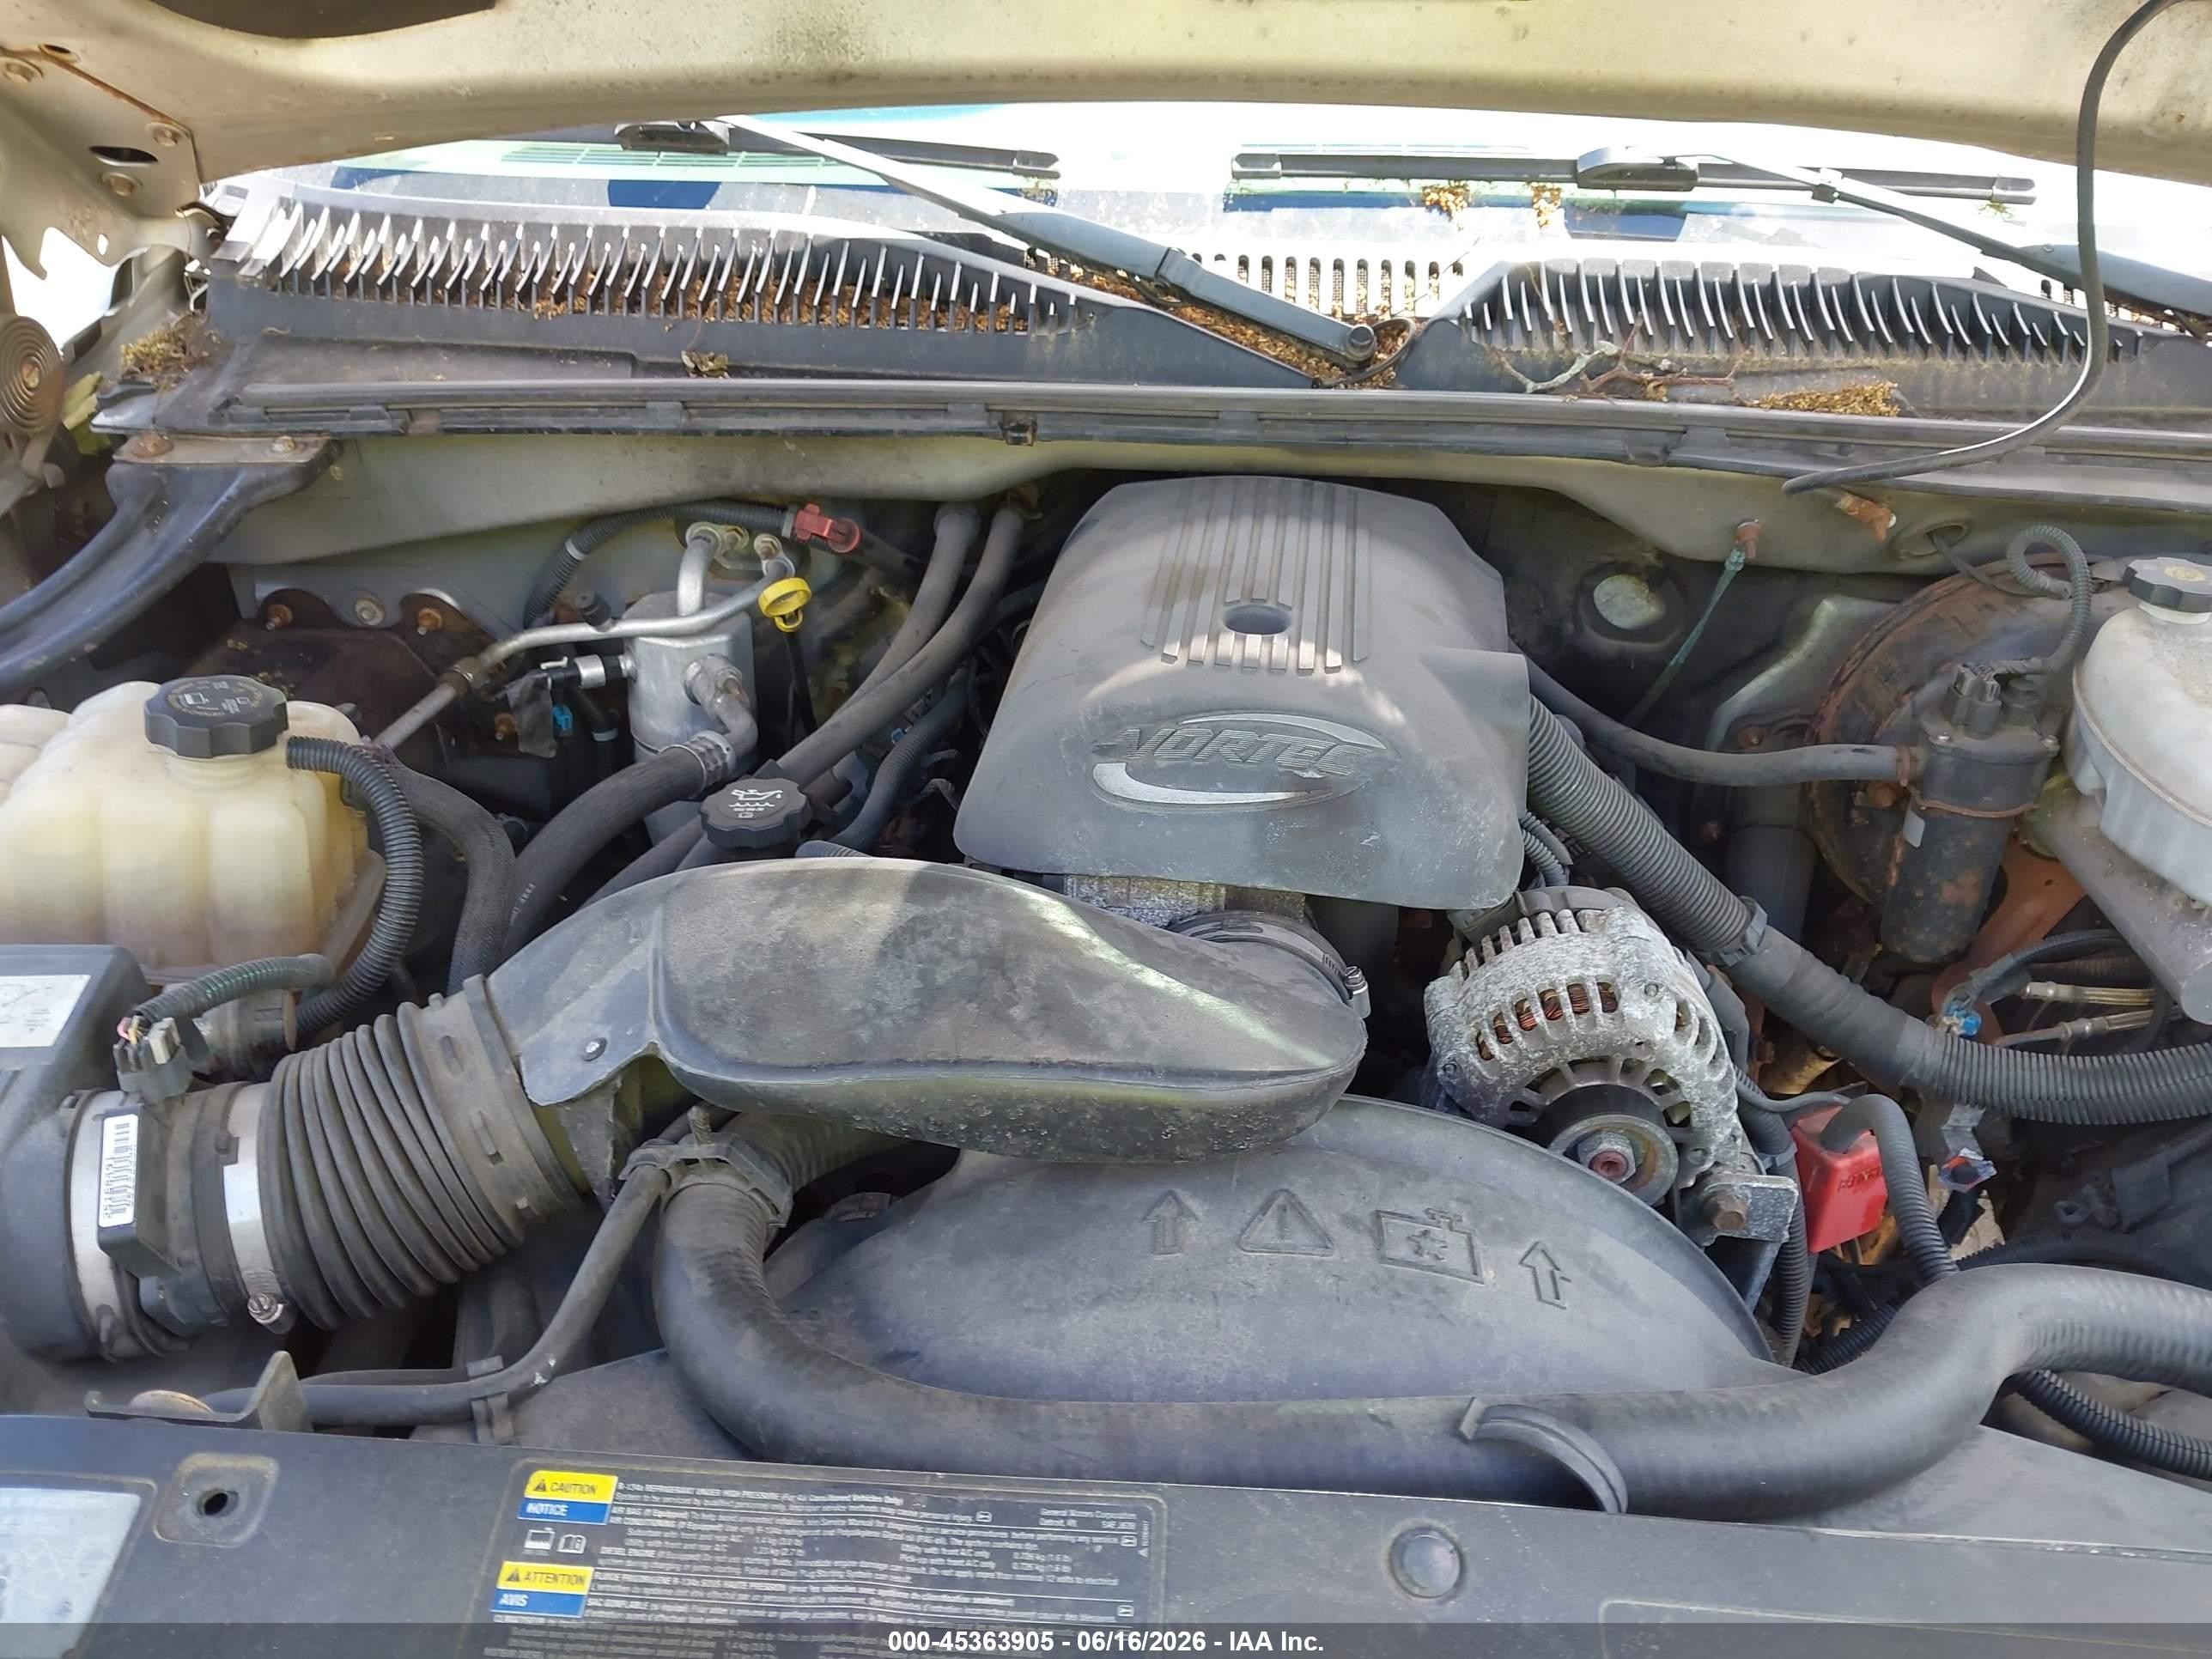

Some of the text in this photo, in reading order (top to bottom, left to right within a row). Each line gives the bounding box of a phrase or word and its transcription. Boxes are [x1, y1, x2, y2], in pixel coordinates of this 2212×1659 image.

[1114, 727, 1377, 776] VORTEC
[549, 1481, 597, 1496] CAUTION
[526, 1503, 569, 1516] NOTICE
[524, 1571, 586, 1586] ATTENTION
[498, 1594, 529, 1607] AVIS
